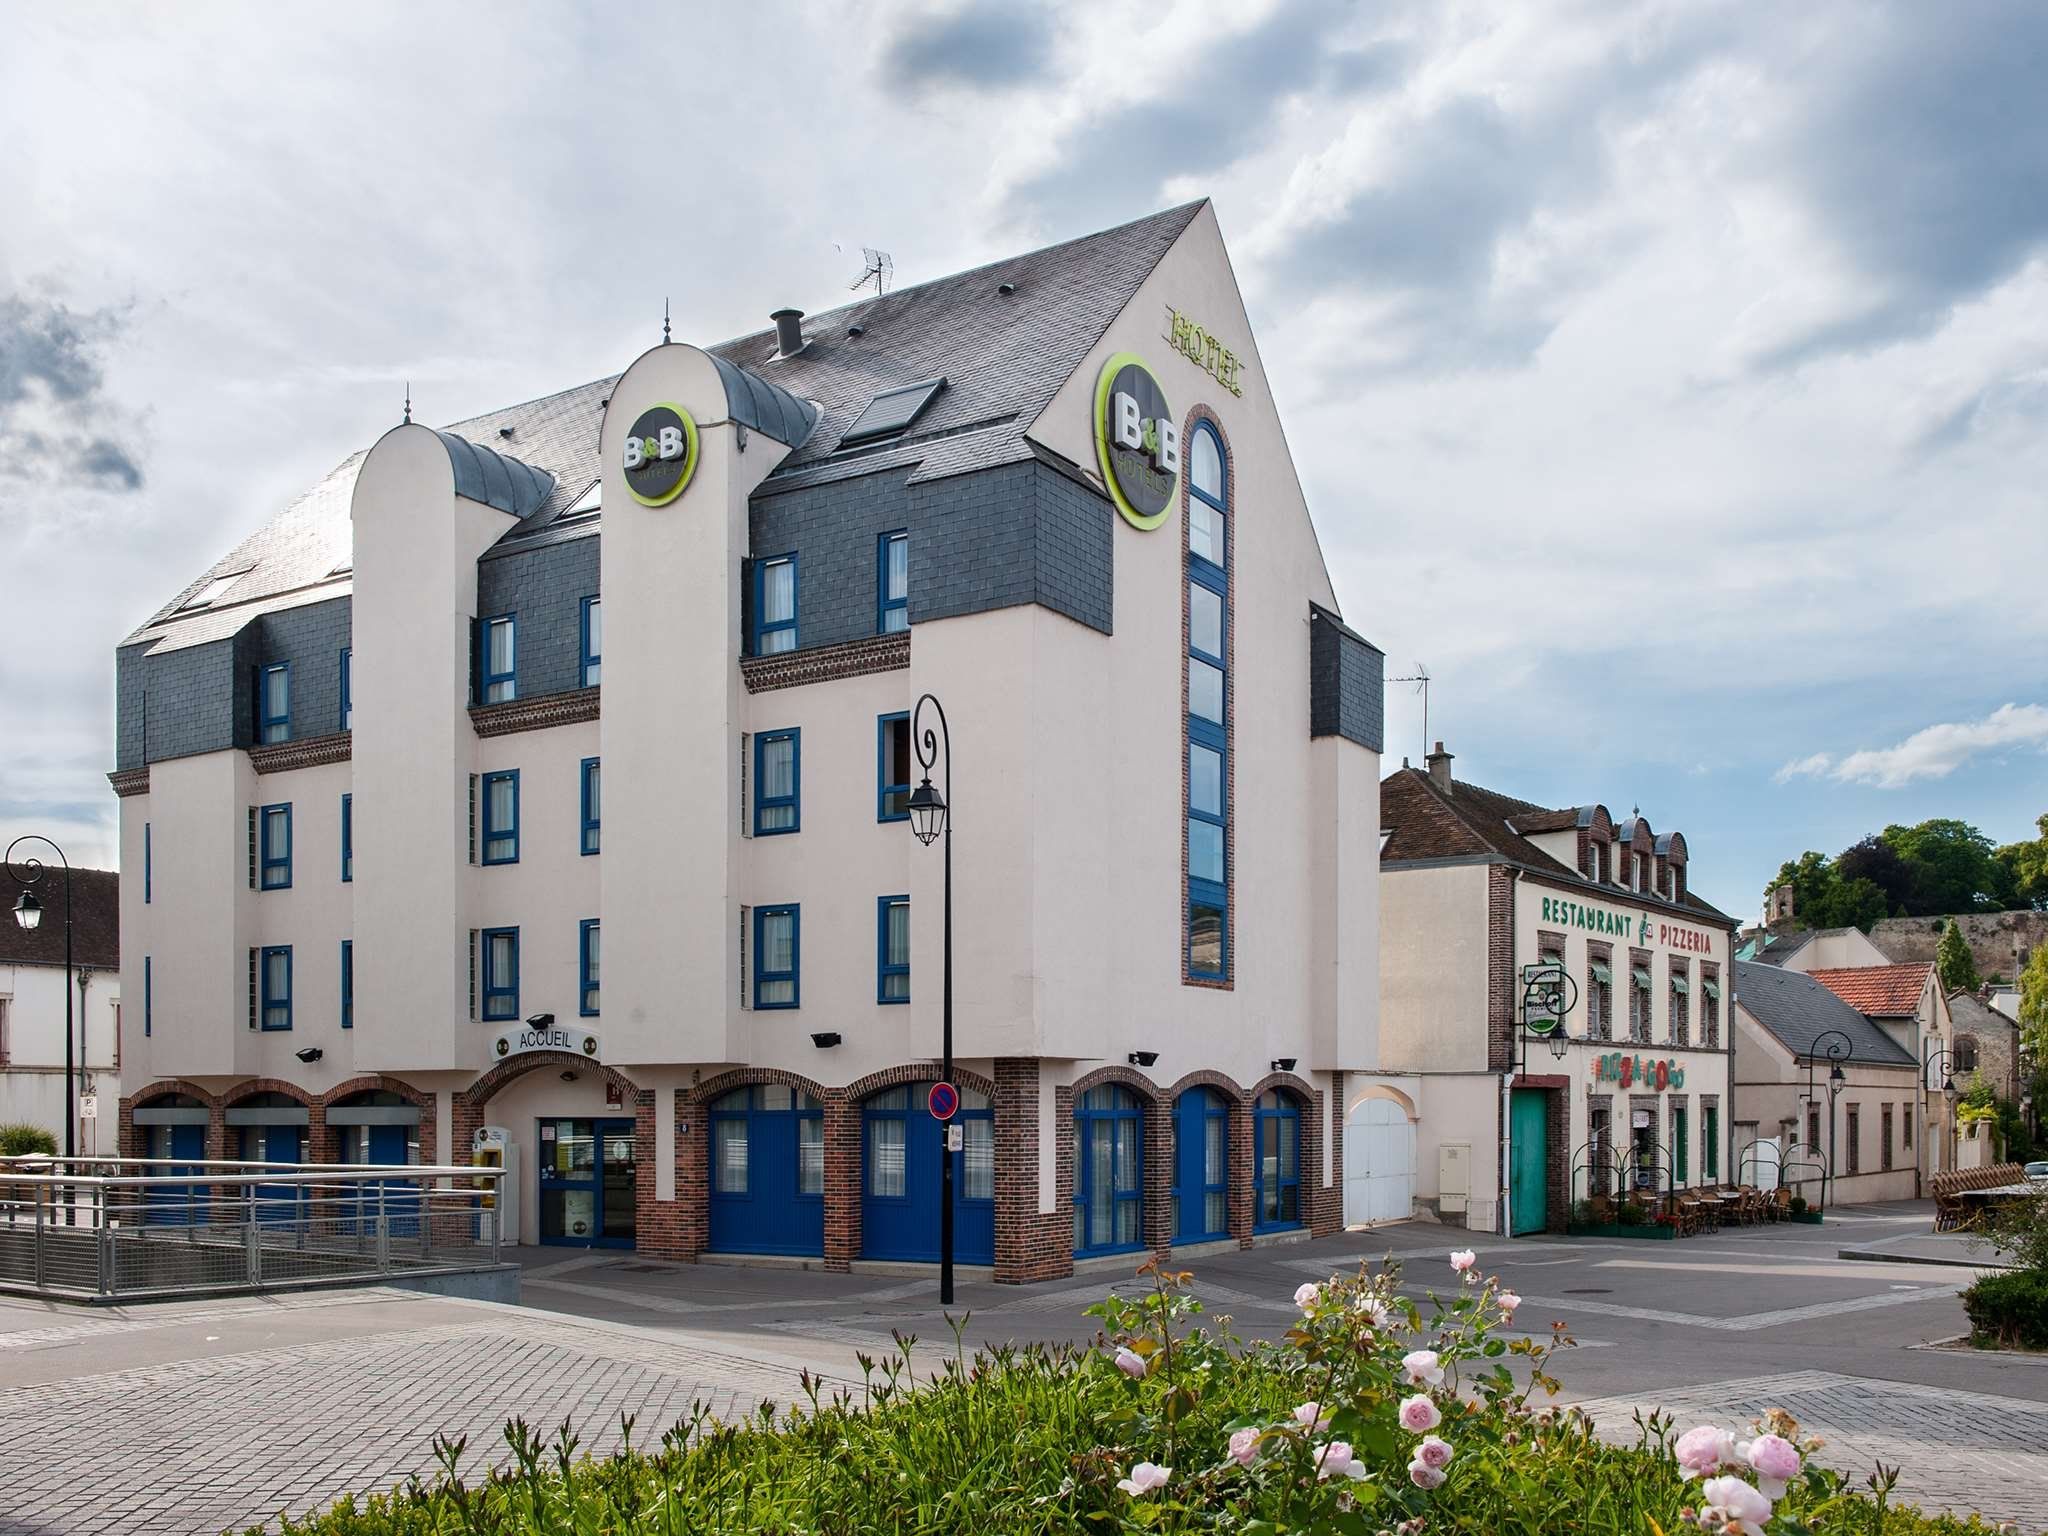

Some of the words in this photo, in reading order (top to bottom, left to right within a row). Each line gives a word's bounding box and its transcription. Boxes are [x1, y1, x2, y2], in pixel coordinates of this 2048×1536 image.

[1172, 310, 1243, 398] HOTEL
[623, 426, 684, 468] B&B
[1115, 391, 1180, 476] B&B
[1542, 897, 1631, 938] RESTAURANT
[1660, 924, 1711, 955] PIZZERIA
[519, 1031, 572, 1048] ACCUEIL
